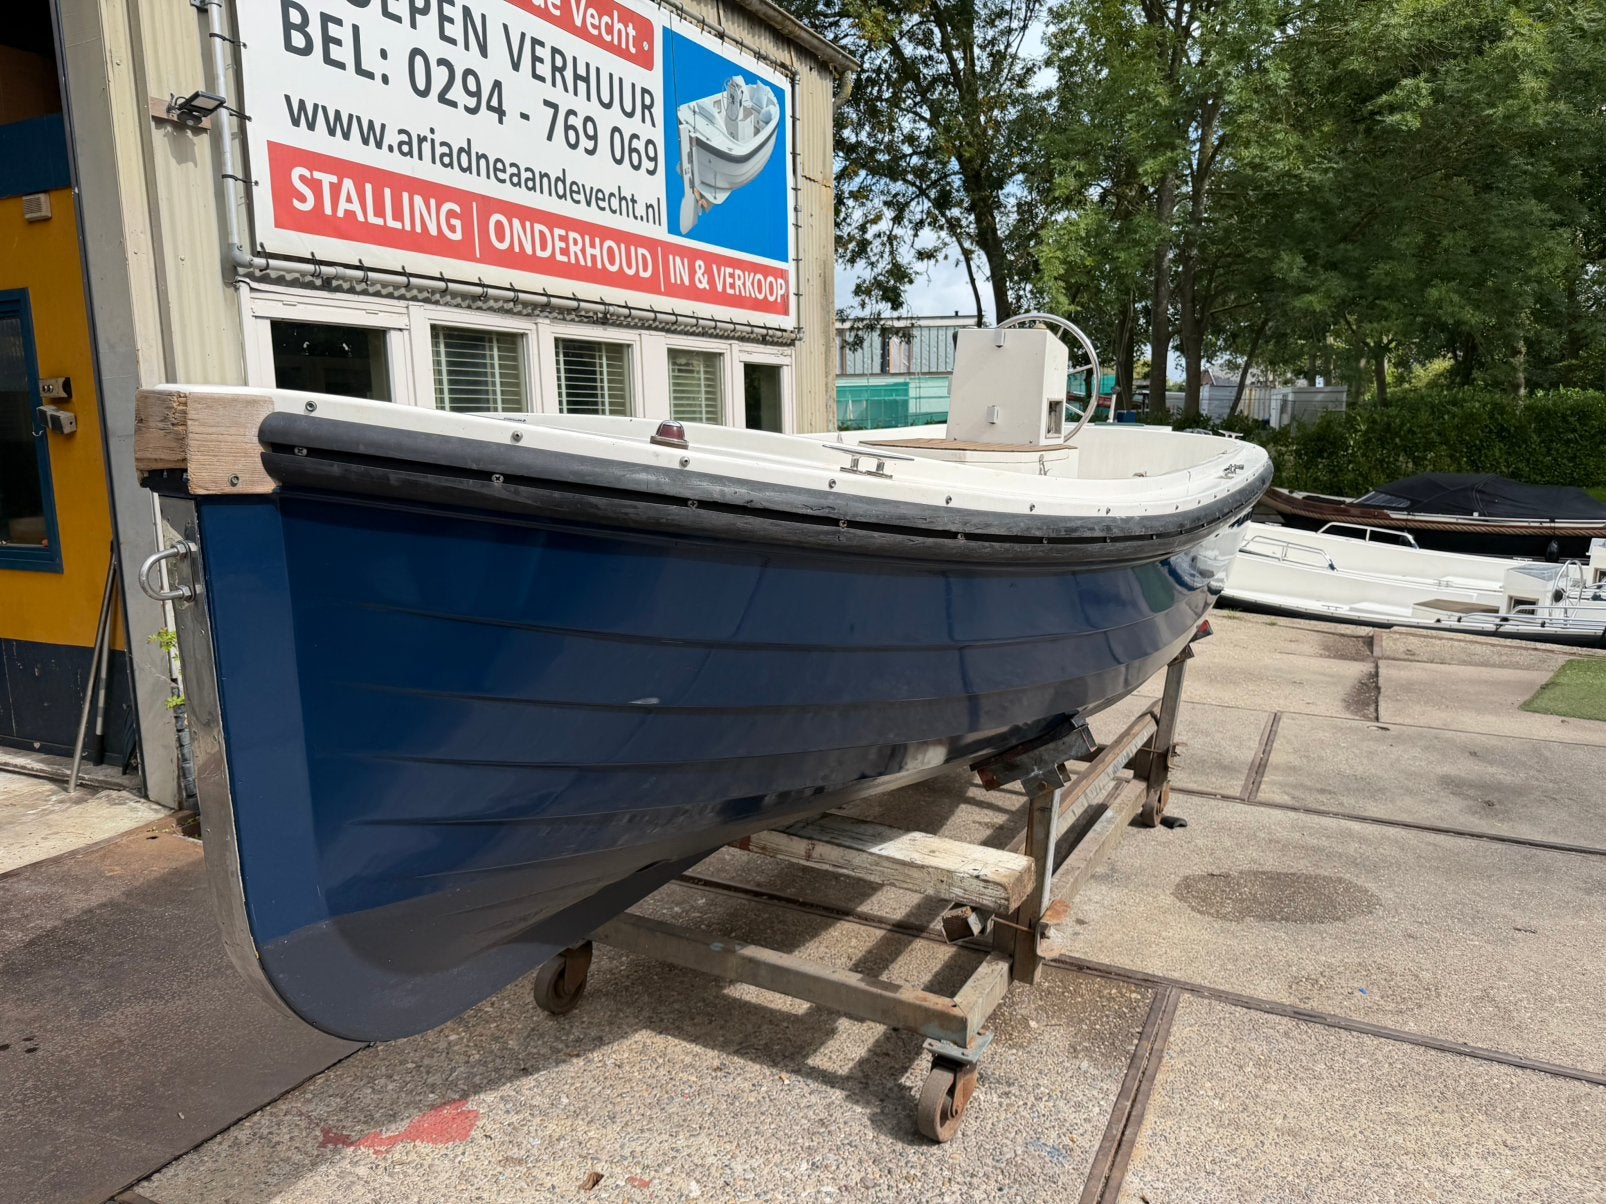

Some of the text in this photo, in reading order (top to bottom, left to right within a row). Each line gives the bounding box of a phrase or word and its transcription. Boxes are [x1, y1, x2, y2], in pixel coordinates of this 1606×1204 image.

[280, 0, 390, 86] BEL:
[408, 47, 506, 126] 0294
[543, 98, 599, 157] 769
[609, 125, 658, 175] 069
[346, 0, 655, 128] PEN VERHUUR
[531, 0, 637, 54] e Vecht
[283, 93, 662, 228] www.ariadneaandevecht.nl
[290, 166, 787, 303] STALLING ONDERHOUD IN & VERKOOP
